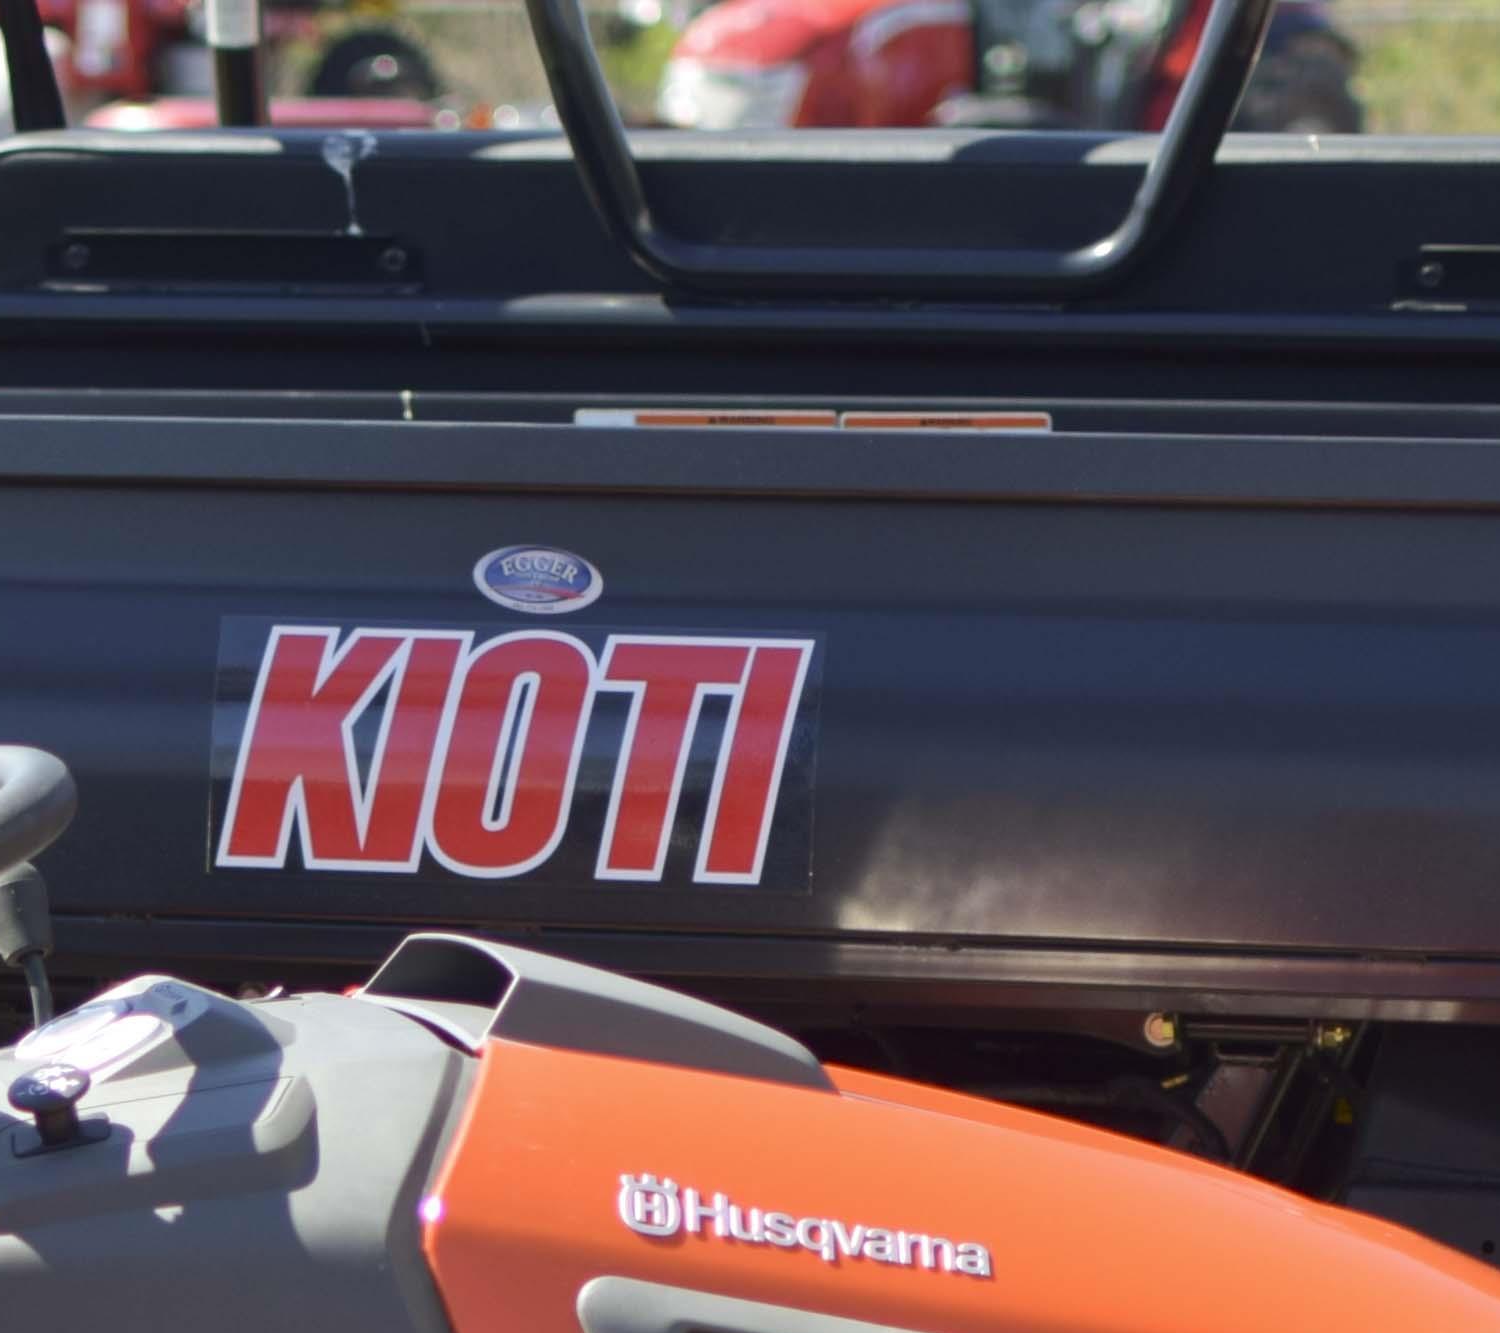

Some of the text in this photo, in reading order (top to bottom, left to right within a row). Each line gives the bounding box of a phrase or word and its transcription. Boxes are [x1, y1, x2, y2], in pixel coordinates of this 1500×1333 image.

[501, 557, 579, 584] EGGER
[216, 624, 816, 885] KIOTI
[685, 1187, 992, 1276] Husqvarna
